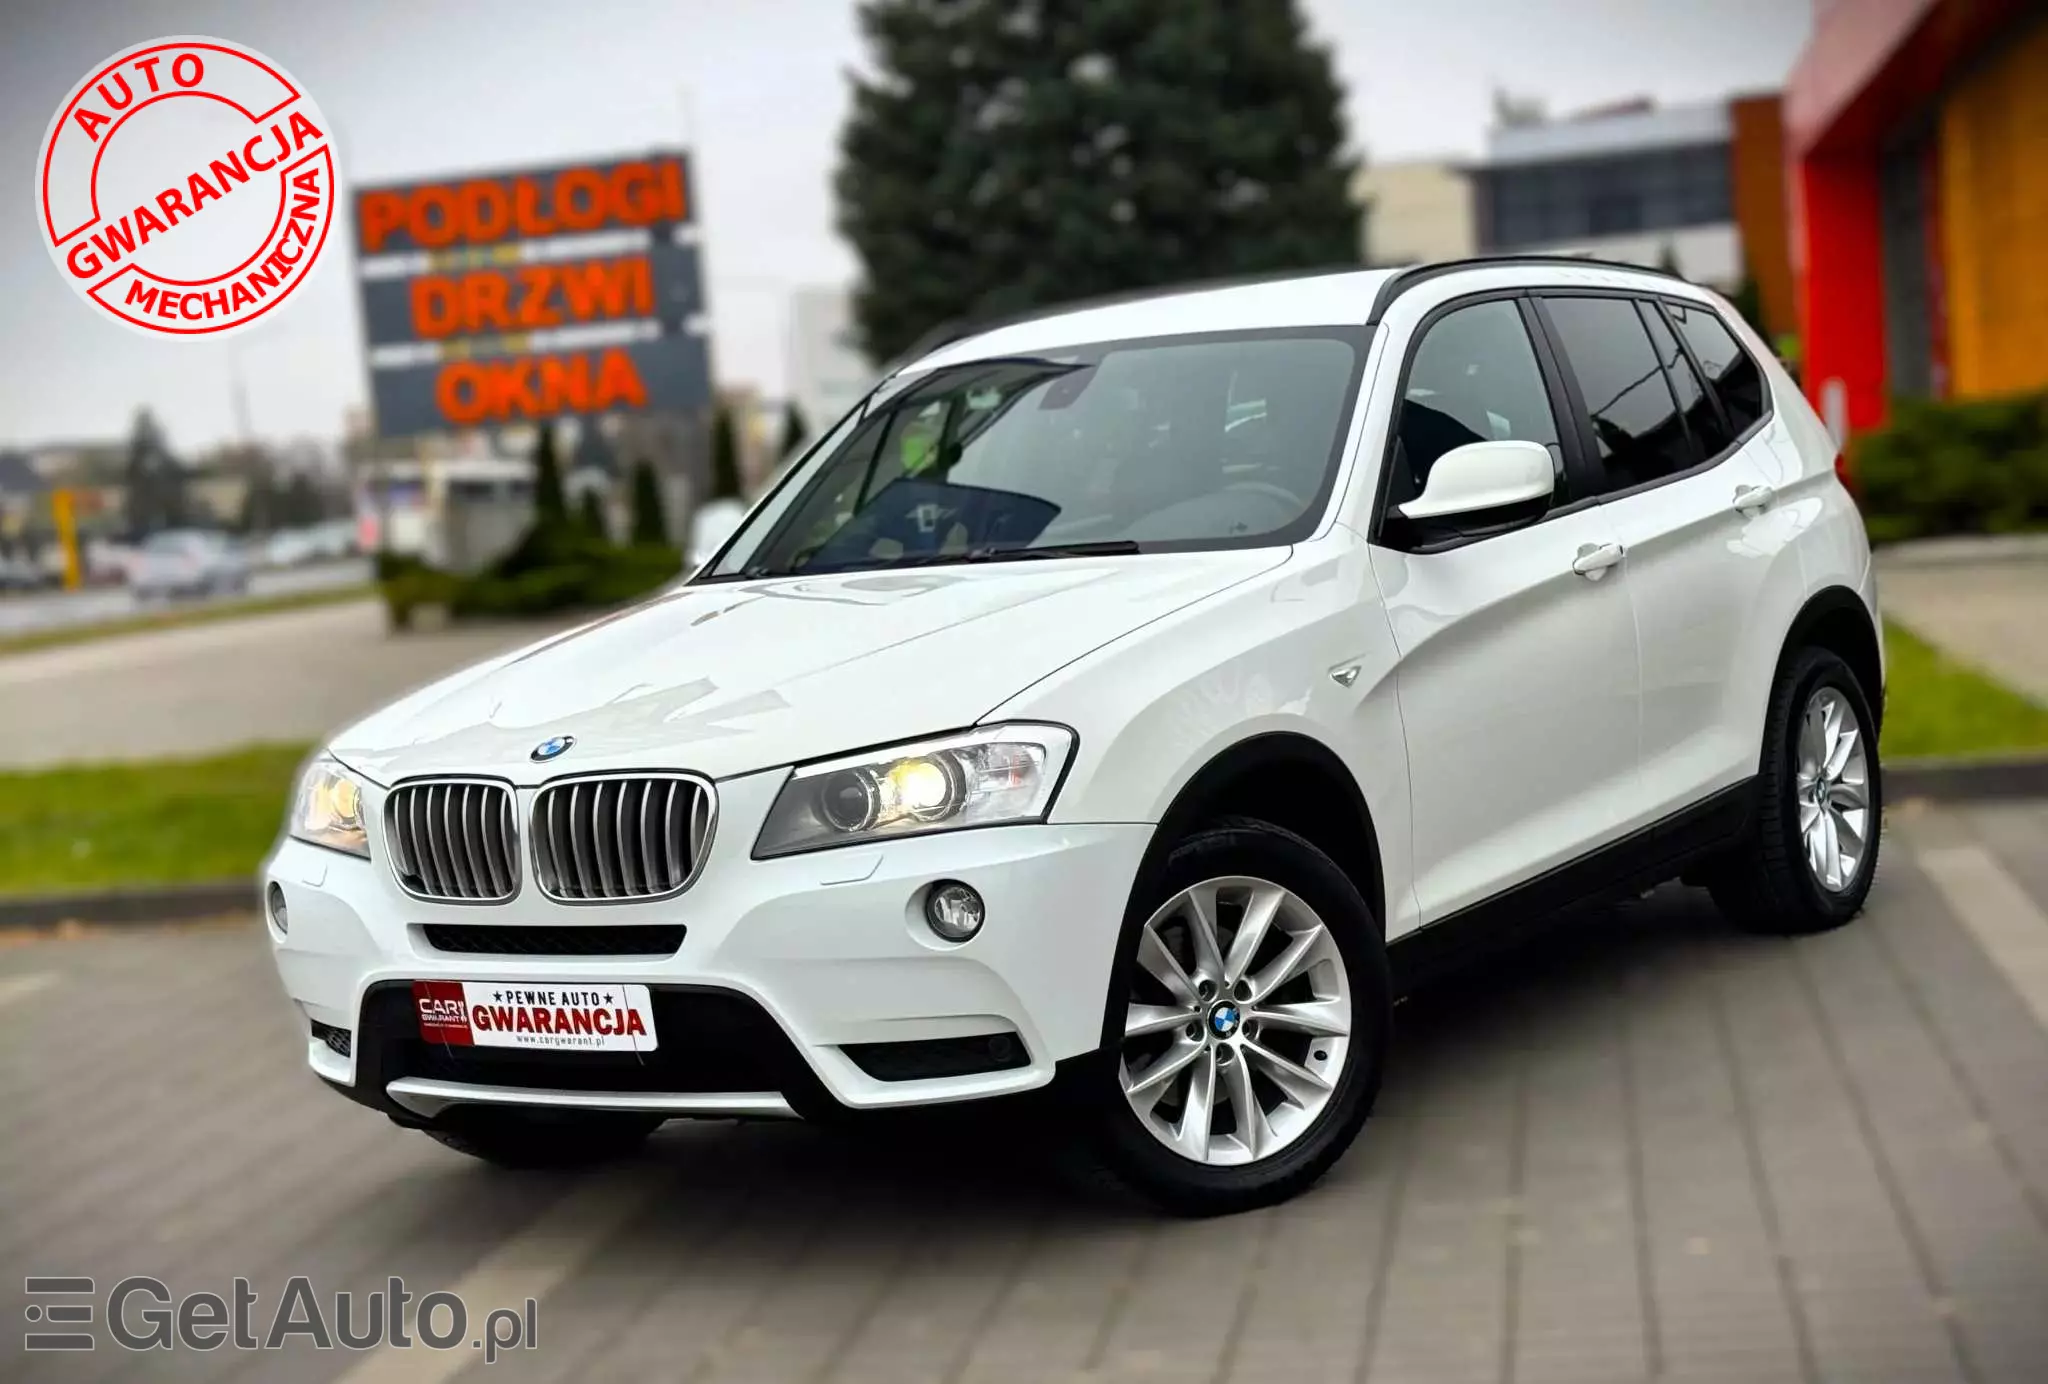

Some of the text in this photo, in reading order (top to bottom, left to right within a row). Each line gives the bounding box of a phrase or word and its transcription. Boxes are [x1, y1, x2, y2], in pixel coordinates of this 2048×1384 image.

[410, 257, 655, 338] DRZWI
[437, 349, 647, 423] OKNA
[472, 1004, 647, 1036] GWARANCJA
[506, 990, 601, 1006] PEWNE AUTO
